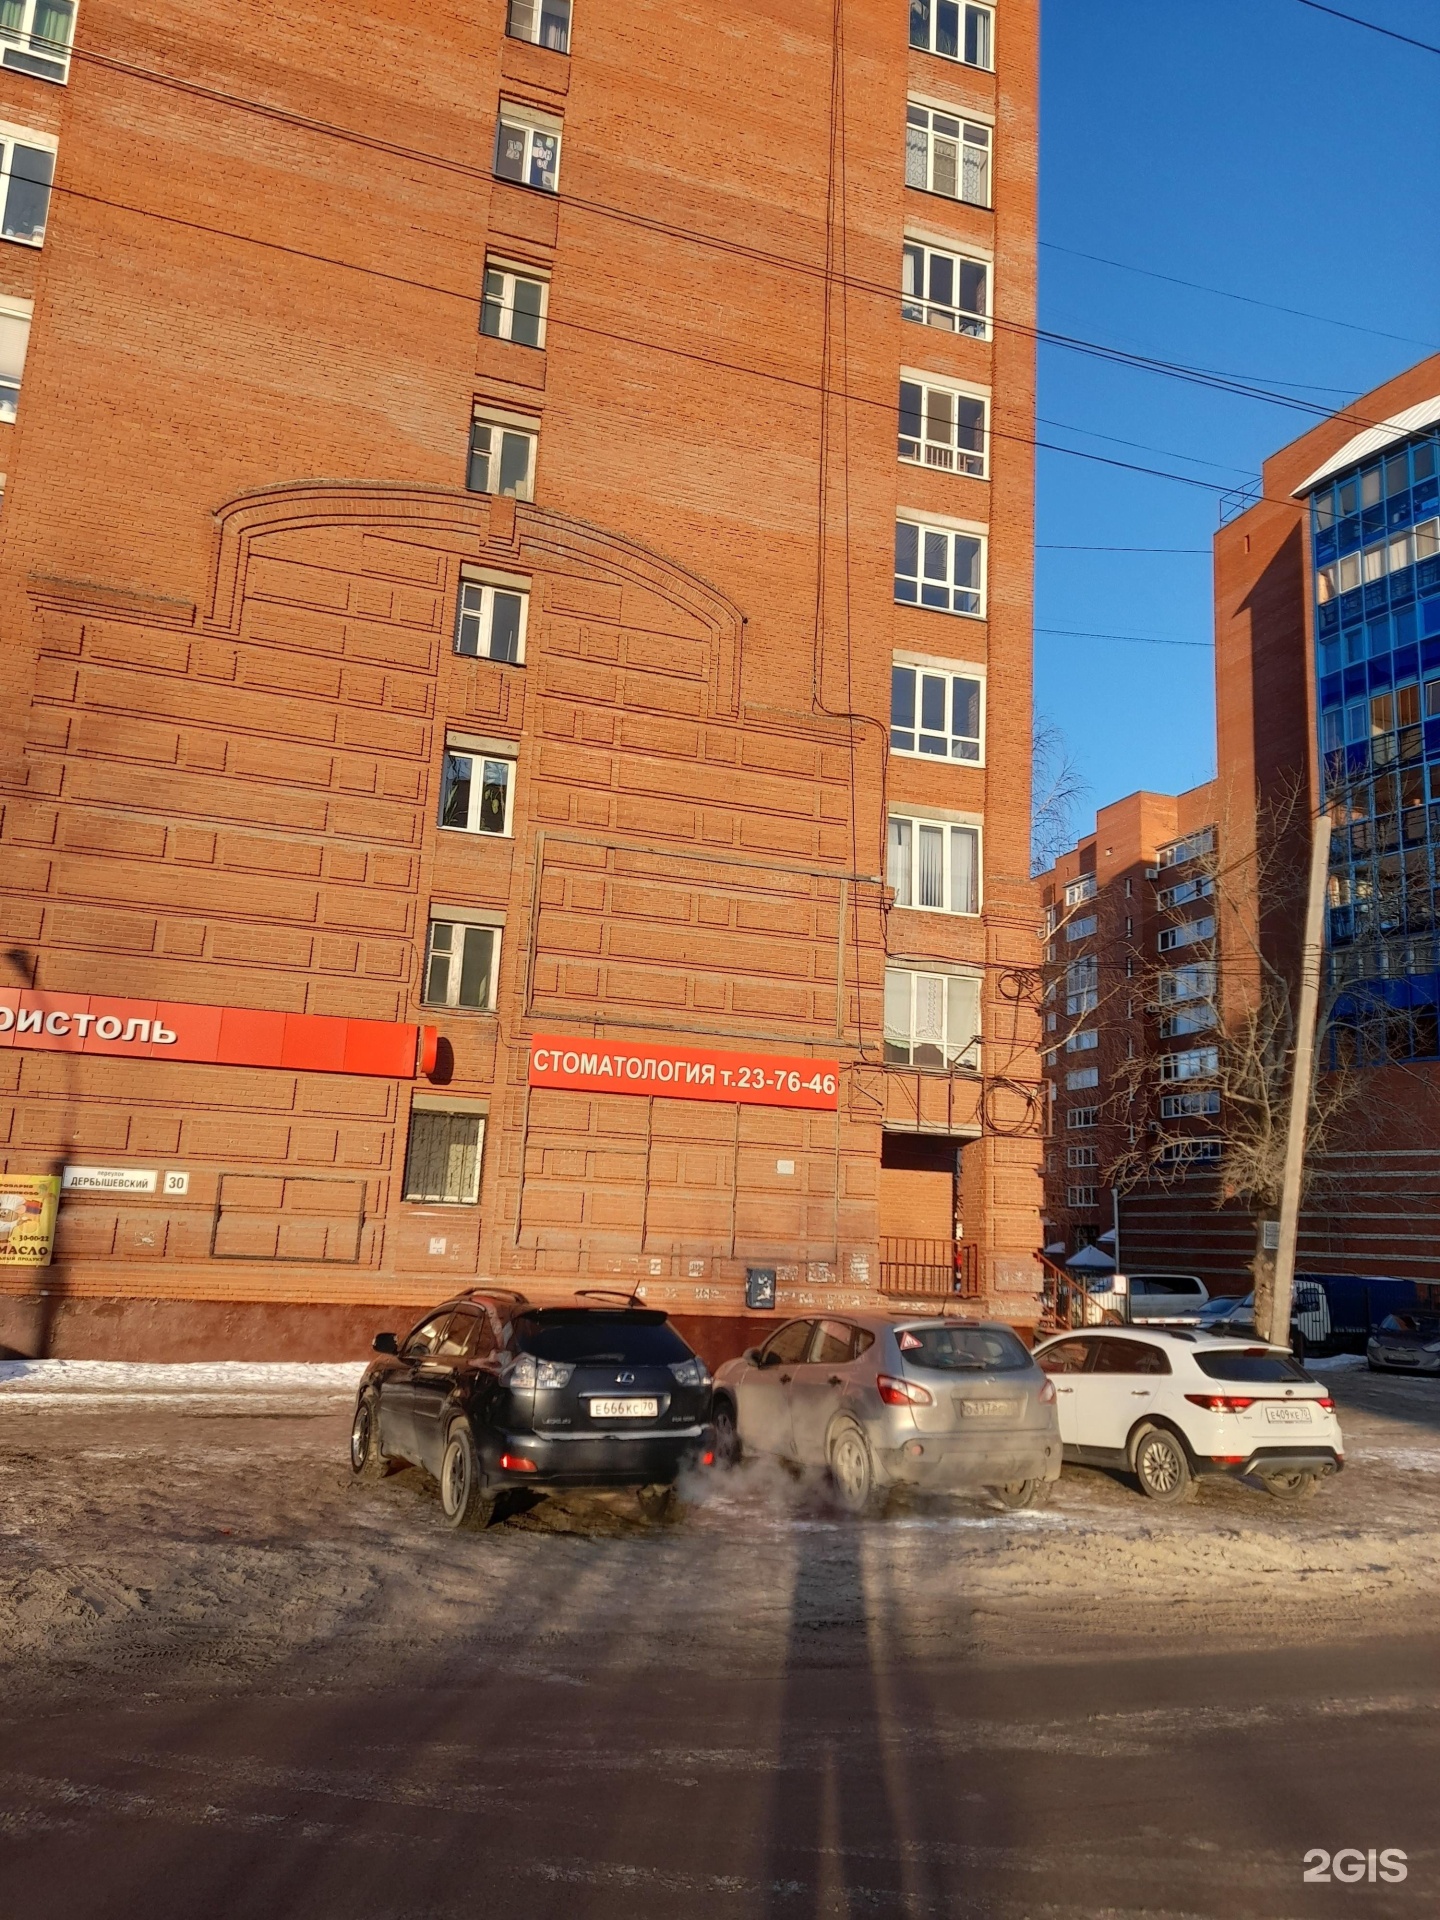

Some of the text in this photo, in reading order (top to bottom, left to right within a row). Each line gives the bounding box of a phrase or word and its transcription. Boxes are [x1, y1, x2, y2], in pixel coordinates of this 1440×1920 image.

[533, 1049, 836, 1095] СТОМАТОЛОГИЯ т.23-76-46
[70, 1177, 148, 1189] ДЕРБЫШЕВСКИЙ
[168, 1176, 184, 1189] 30
